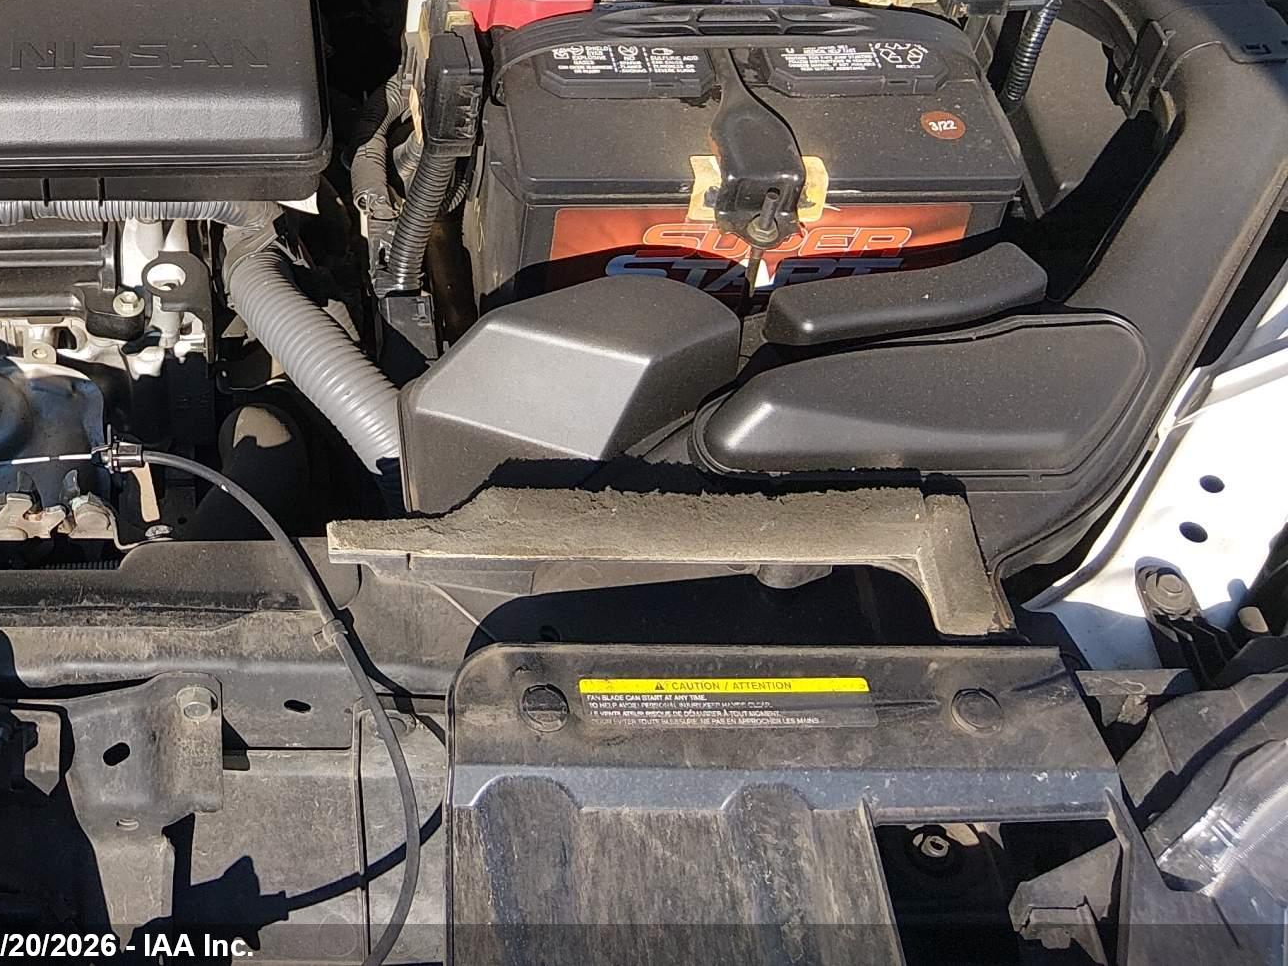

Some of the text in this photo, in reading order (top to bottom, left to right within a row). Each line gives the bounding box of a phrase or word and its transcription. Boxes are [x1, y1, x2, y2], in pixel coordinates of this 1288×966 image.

[8, 40, 272, 71] NISSAN
[928, 120, 958, 132] 3/22
[671, 681, 720, 691] CAUTION
[733, 681, 792, 690] ATTENTION
